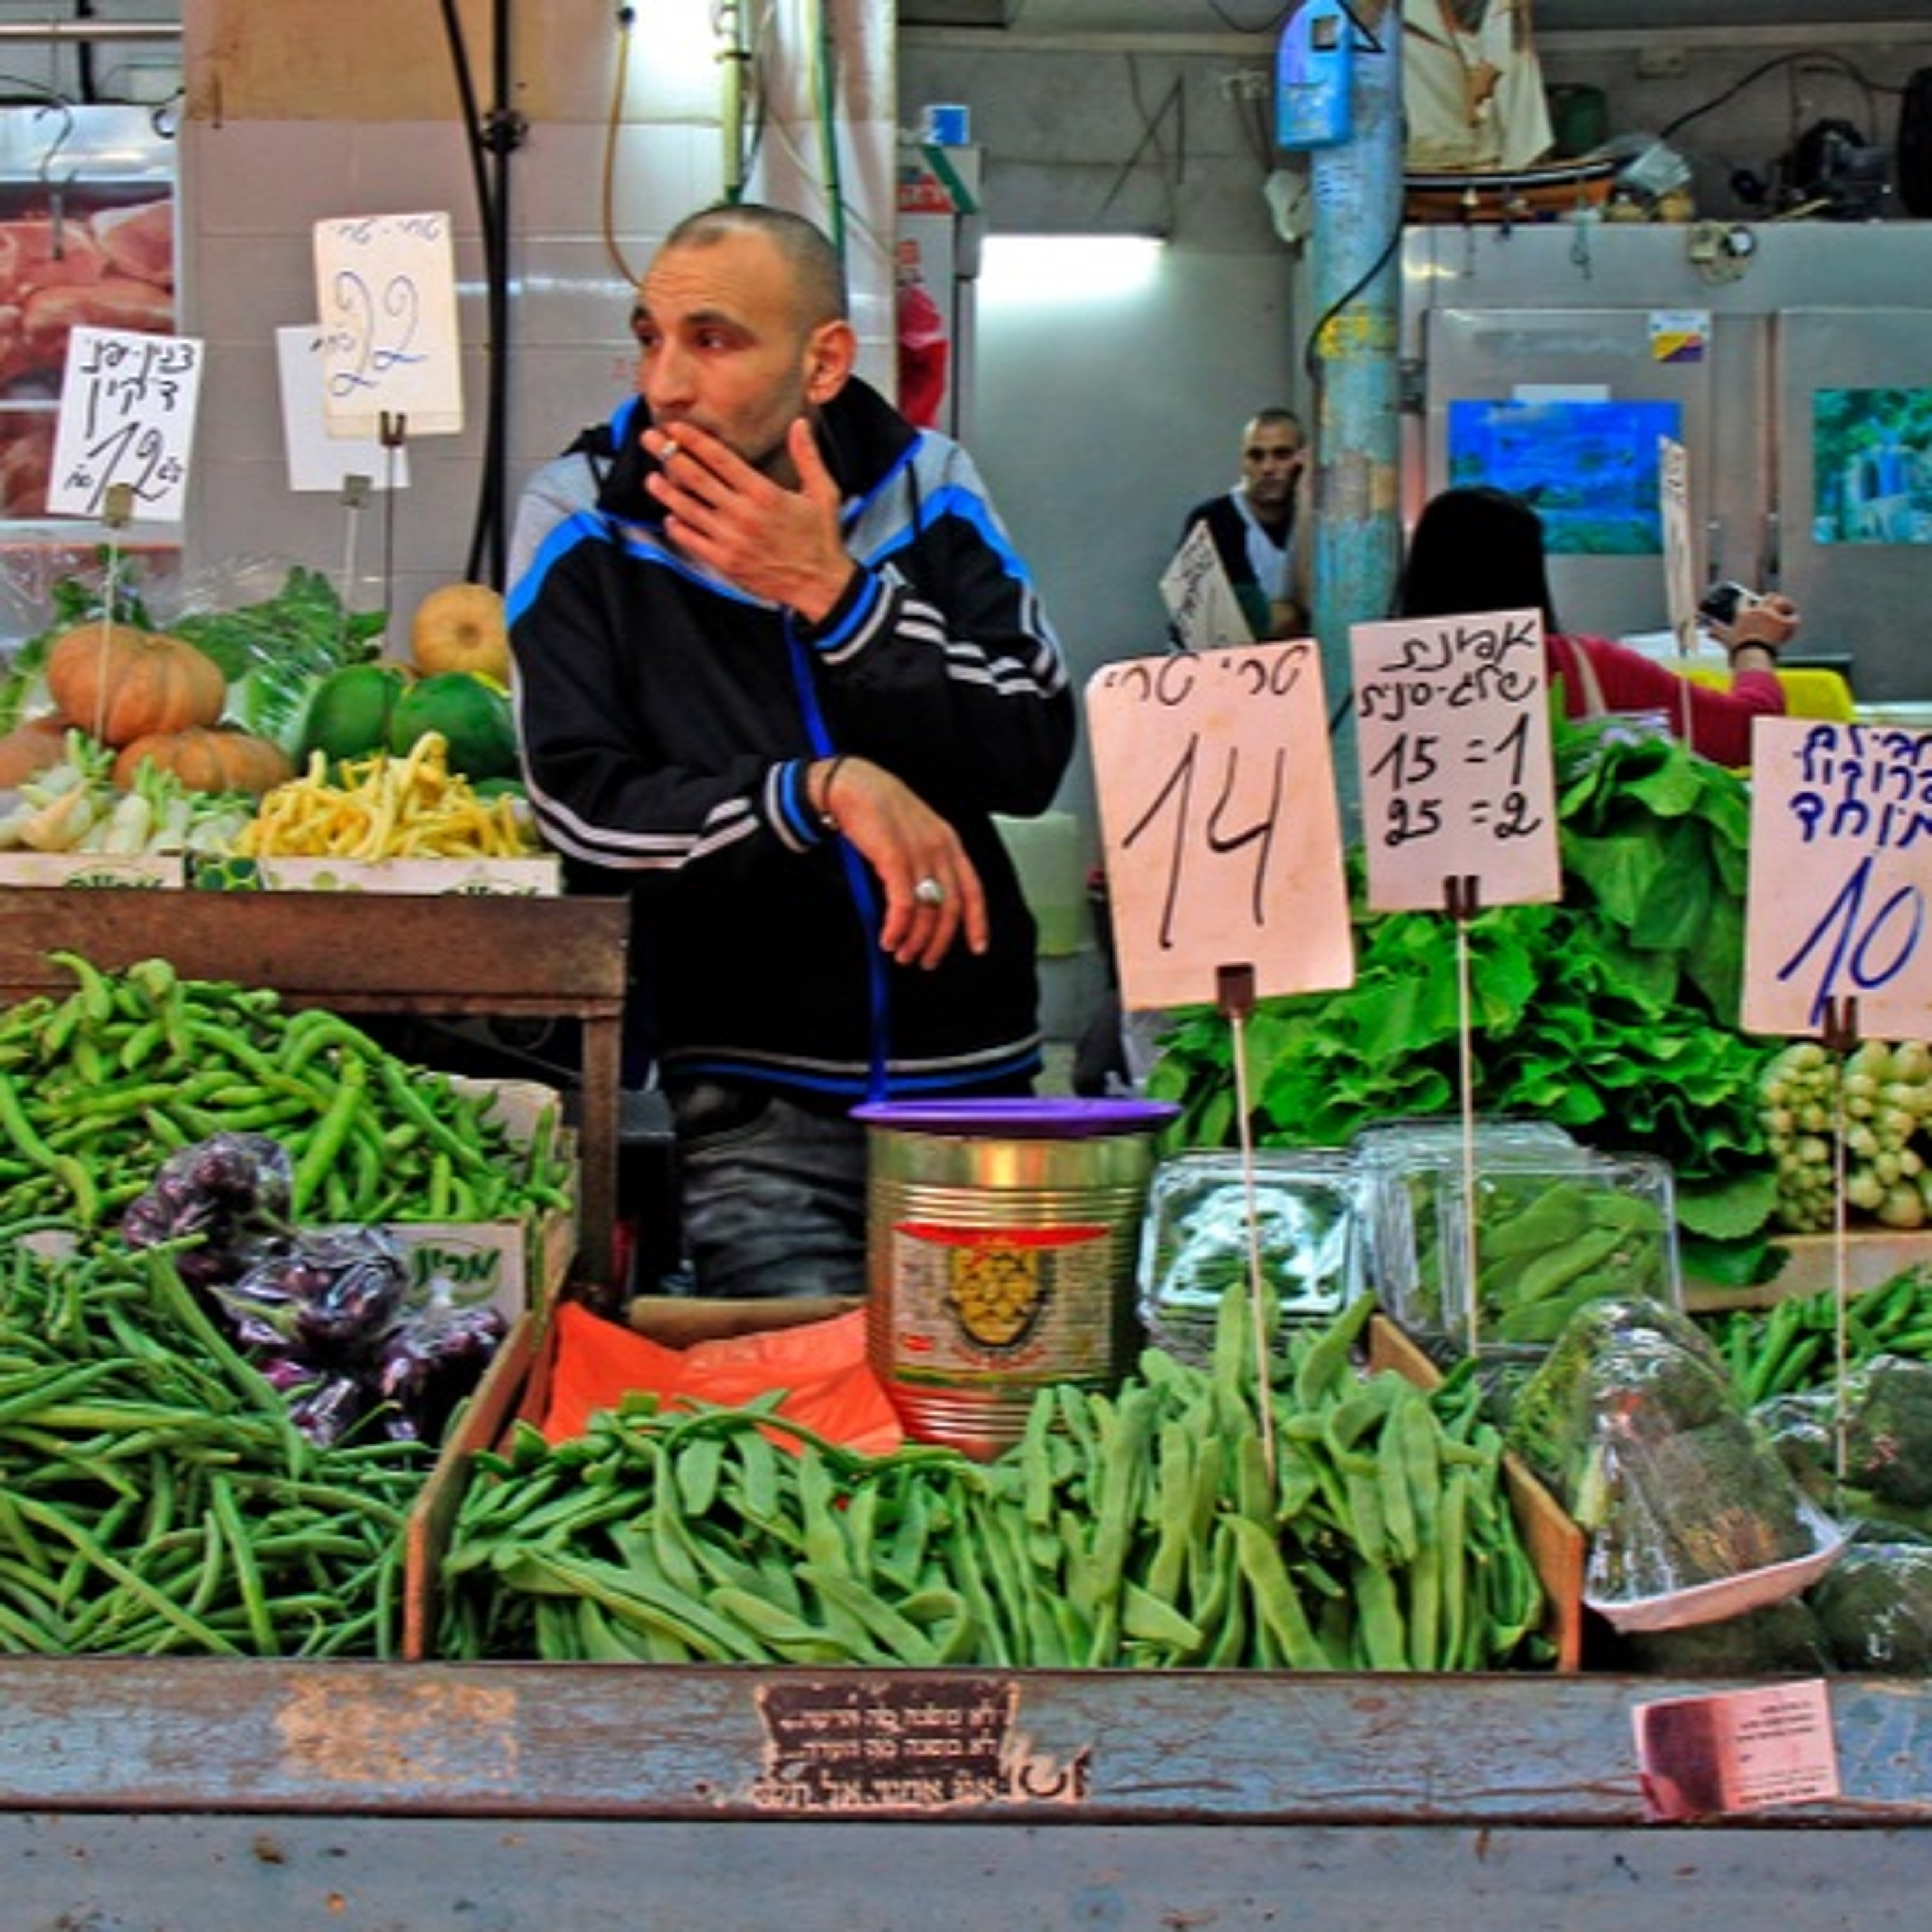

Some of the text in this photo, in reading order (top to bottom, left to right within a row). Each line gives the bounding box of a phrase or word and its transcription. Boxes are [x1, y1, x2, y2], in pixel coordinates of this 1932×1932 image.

[332, 270, 429, 397] 22
[86, 421, 171, 513] 12
[1369, 734, 1439, 791] 15
[1121, 732, 1287, 949] 14
[1385, 798, 1443, 847] 25
[1777, 857, 1924, 1027] 10
